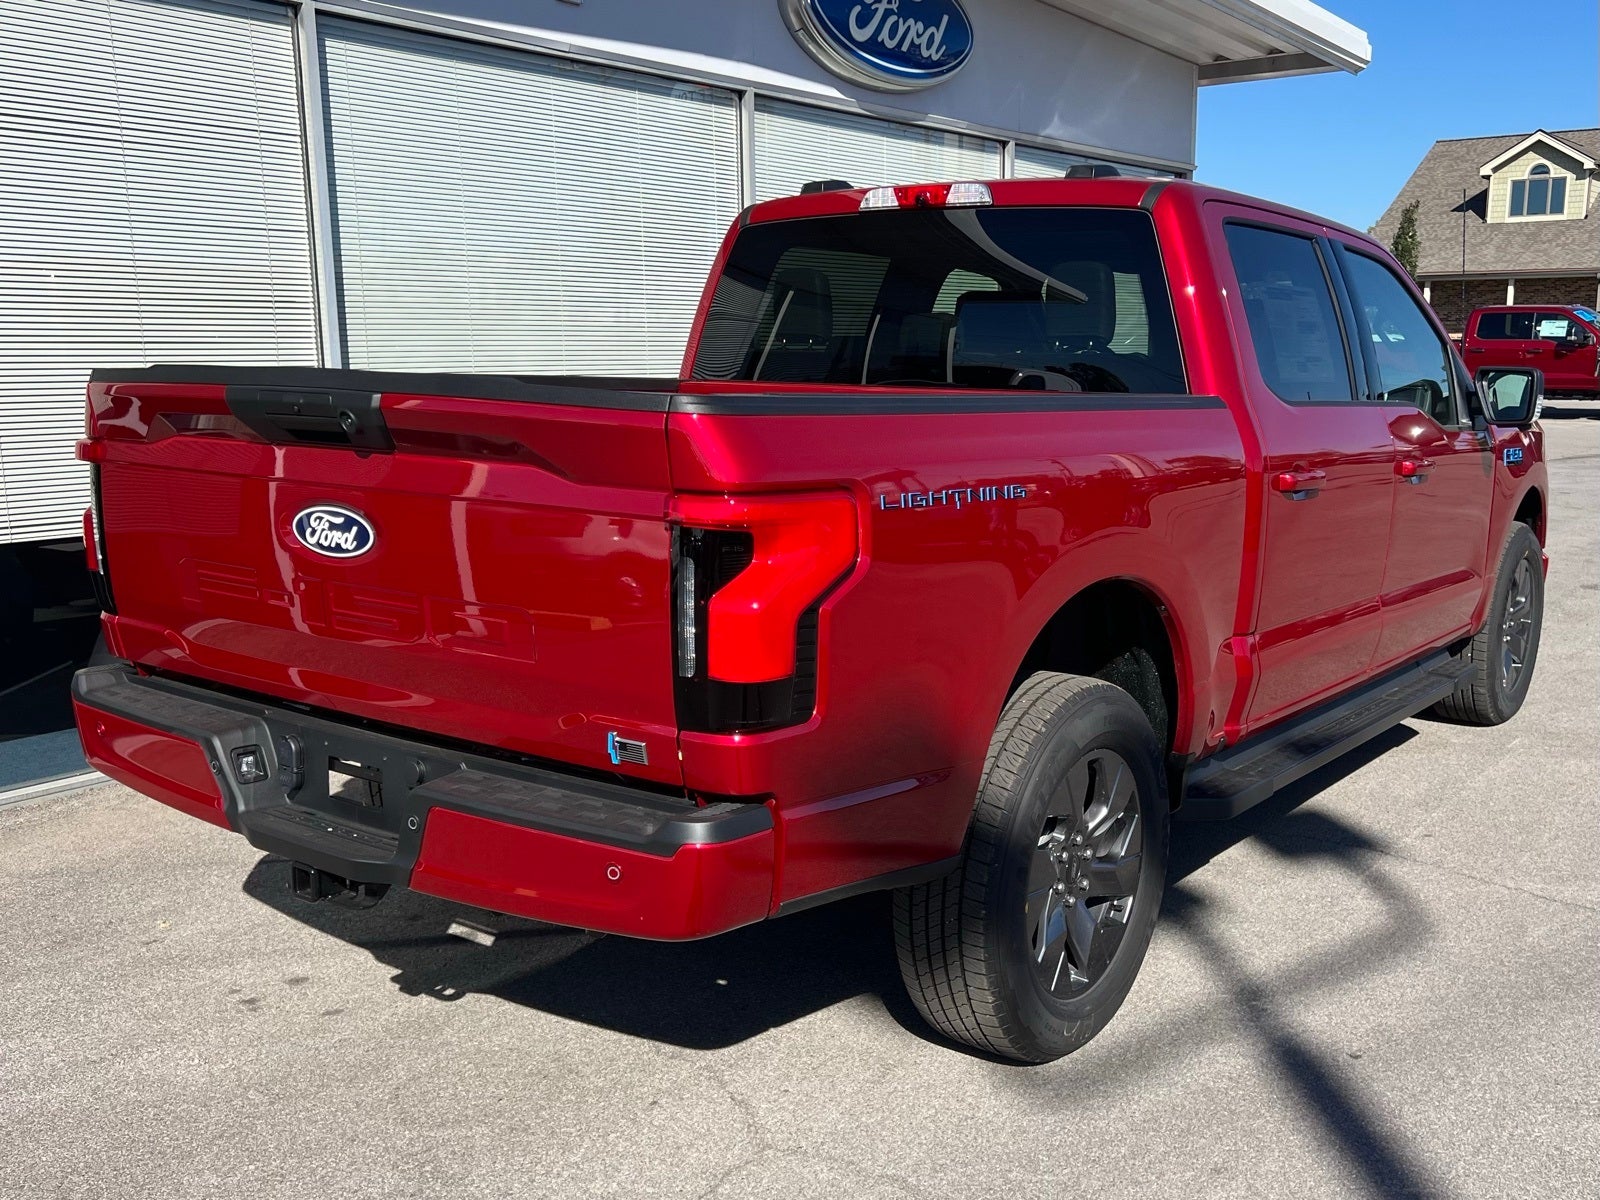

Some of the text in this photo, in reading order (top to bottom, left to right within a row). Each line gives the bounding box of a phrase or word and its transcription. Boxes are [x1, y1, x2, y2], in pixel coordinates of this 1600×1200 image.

[848, 0, 949, 62] Ford
[879, 484, 1027, 510] LIGHTNING
[305, 512, 358, 551] Ford
[178, 556, 537, 664] F-150
